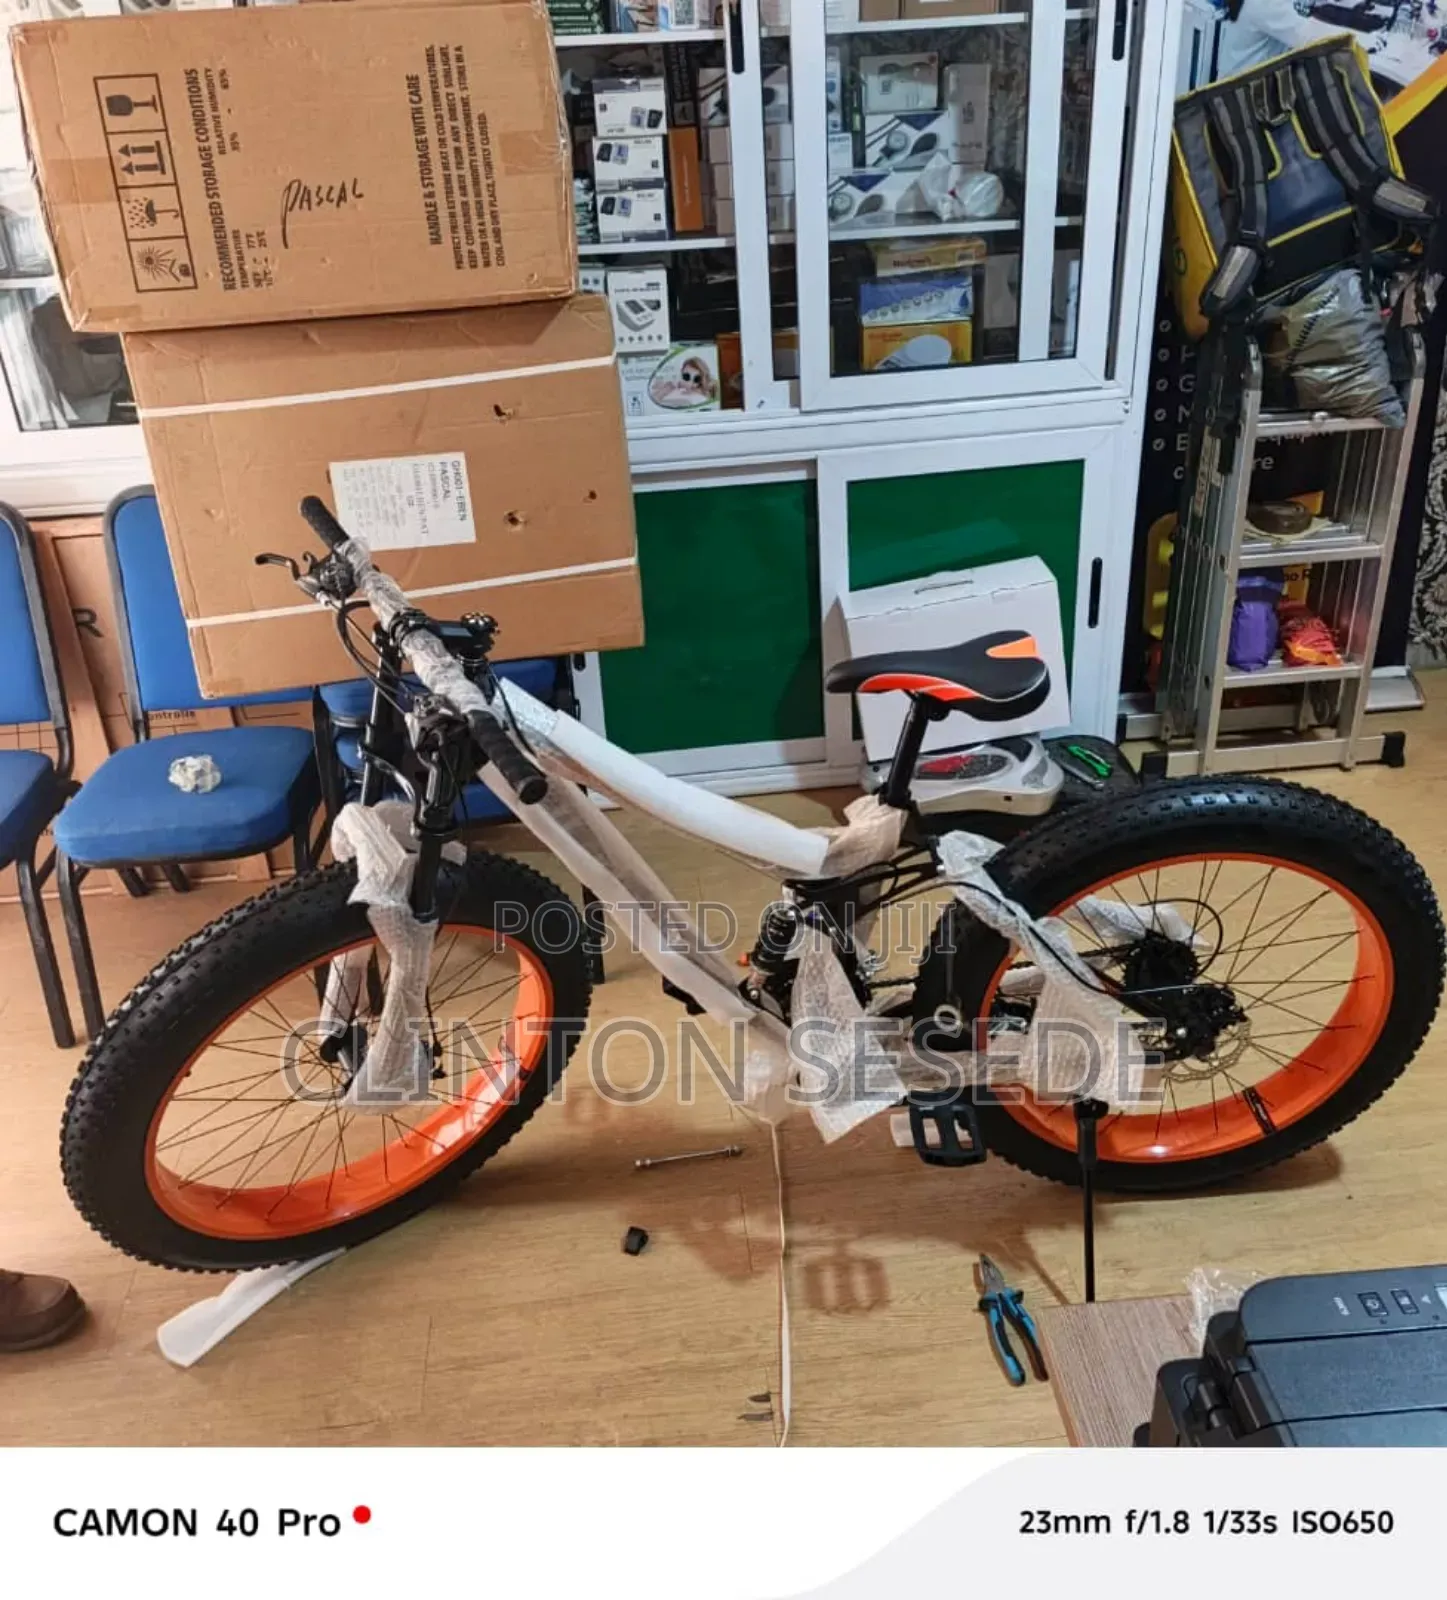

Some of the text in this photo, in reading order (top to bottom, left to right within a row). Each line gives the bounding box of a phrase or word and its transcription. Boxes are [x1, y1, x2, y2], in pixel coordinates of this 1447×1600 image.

[455, 53, 464, 63] IN
[456, 65, 469, 91] STORE
[204, 67, 227, 155] RELATIVE HUMIDITY
[446, 91, 459, 122] DIRECT
[434, 113, 446, 137] COLD
[450, 125, 461, 143] ANY
[438, 138, 448, 150] OR
[405, 73, 442, 245] HANDLE & STORAGE WITH CARE
[440, 151, 451, 172] HEAT
[454, 146, 465, 170] FROM
[481, 148, 494, 181] TIGHTLY
[184, 68, 237, 292] RECOMMENDED STORAGE CONDITIONS
[457, 174, 468, 198] AWAY
[469, 159, 483, 198] HUMIDITY
[443, 173, 456, 210] EXTREME
[281, 177, 364, 249] PASCAL
[474, 199, 485, 220] HIGH
[489, 210, 500, 226] DRY
[448, 211, 460, 235] FROM
[461, 200, 475, 246] CONTAINER
[477, 228, 488, 240] OR
[491, 227, 502, 244] AND
[452, 235, 464, 270] PROTECT
[467, 248, 479, 269] KEEP
[480, 241, 491, 268] WATER
[495, 244, 505, 267] COOL
[439, 461, 451, 500] PASCAL
